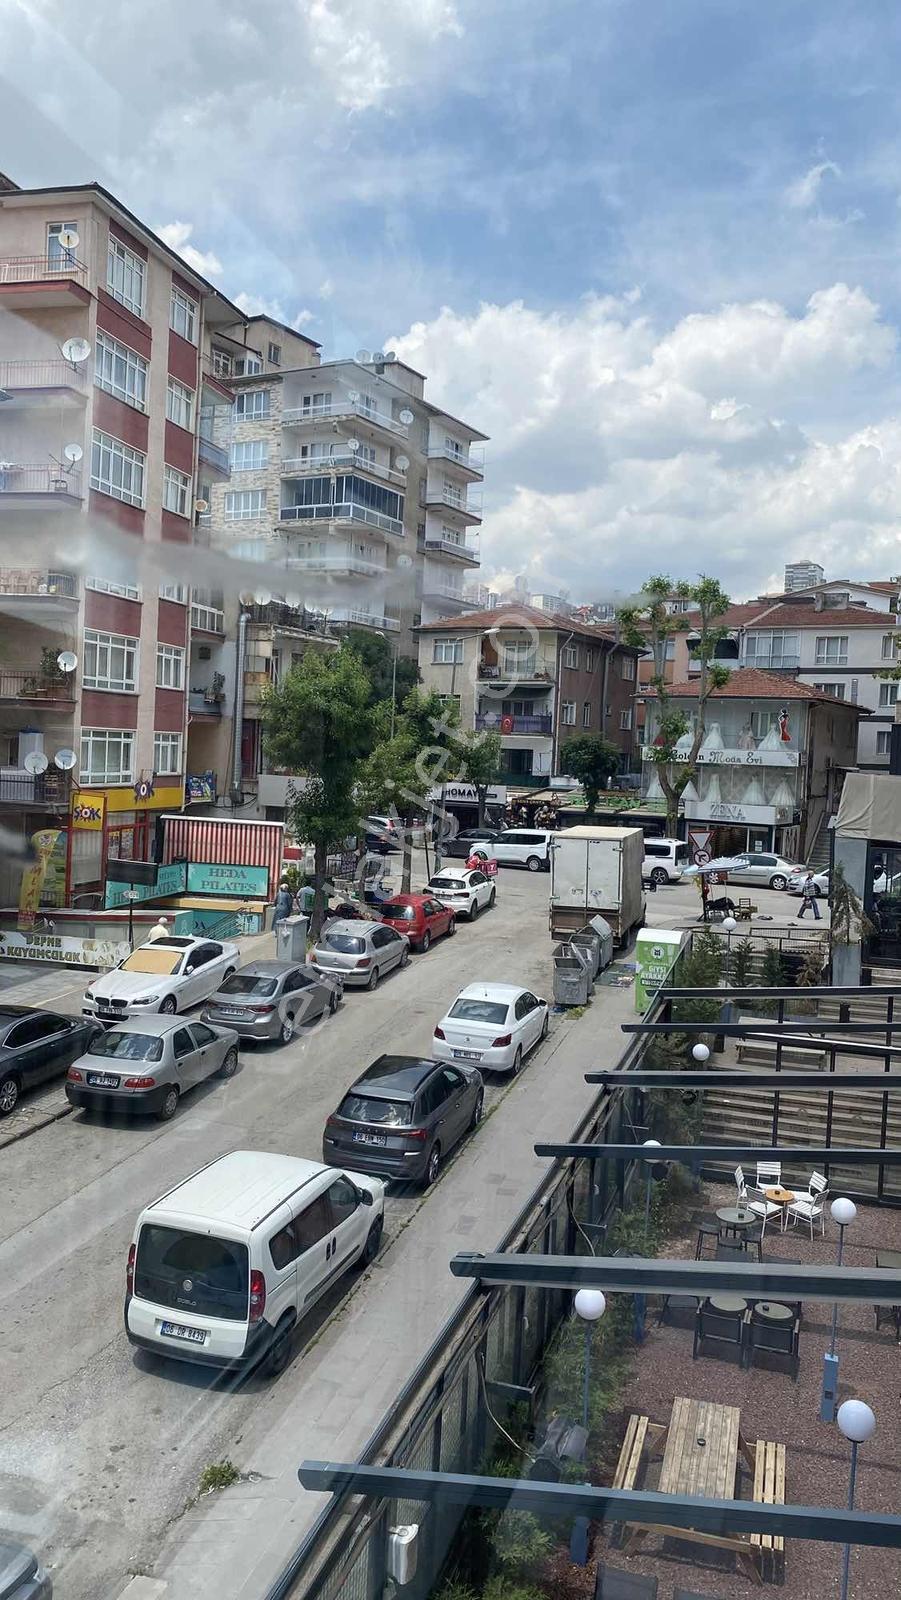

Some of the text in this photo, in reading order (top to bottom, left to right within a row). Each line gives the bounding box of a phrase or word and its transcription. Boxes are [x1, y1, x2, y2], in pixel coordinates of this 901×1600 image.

[709, 751, 742, 763] Moda
[208, 868, 248, 879] HEDA
[201, 880, 257, 892] PILATES
[26, 935, 62, 948] DEFNE
